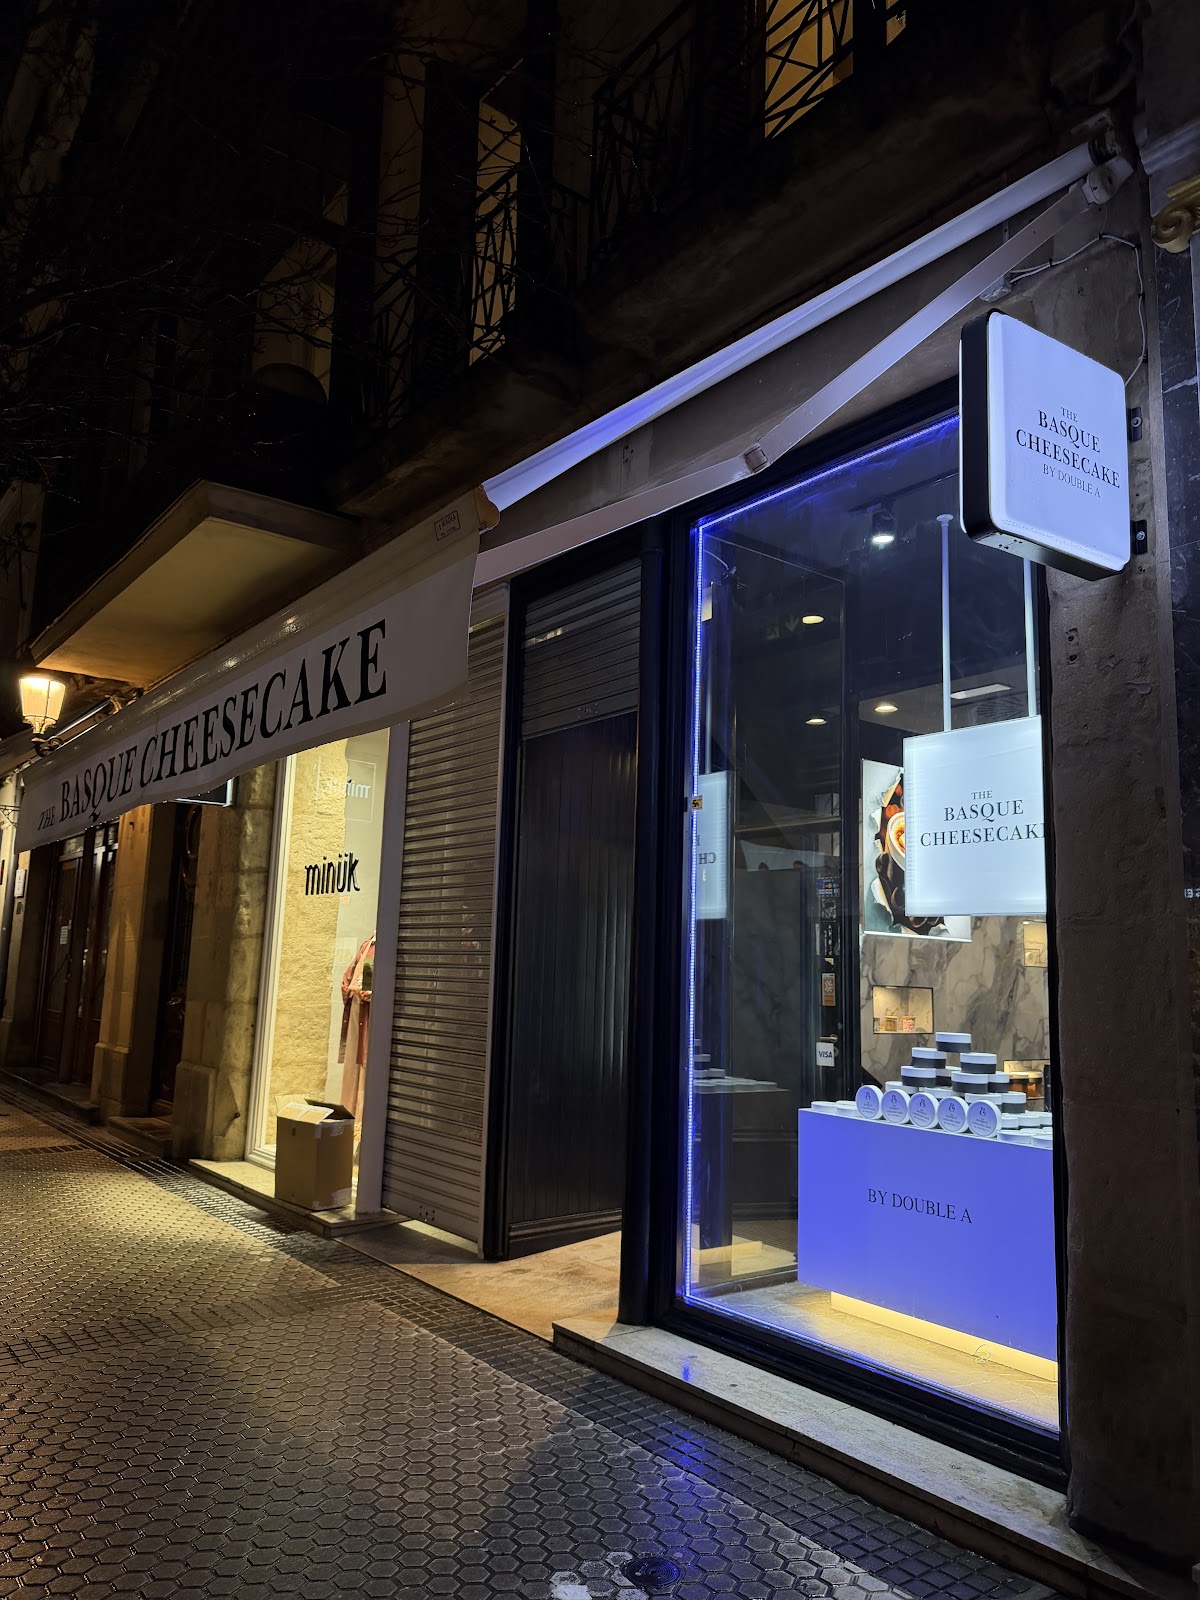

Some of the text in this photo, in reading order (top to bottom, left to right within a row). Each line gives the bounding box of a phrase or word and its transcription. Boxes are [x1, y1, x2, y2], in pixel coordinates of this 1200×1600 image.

[1038, 409, 1101, 453] BASQUE
[1060, 407, 1078, 422] THE
[1016, 428, 1120, 488] CHEESECAKE
[1043, 463, 1101, 498] BY DOUBLE A
[37, 619, 388, 831] THE BASQUE CHEESECAKE
[944, 799, 1024, 822] BASQUE
[971, 790, 993, 800] THE
[304, 851, 361, 896] minük
[818, 1050, 833, 1058] VISA
[868, 1188, 973, 1224] BY DOUBLE A
